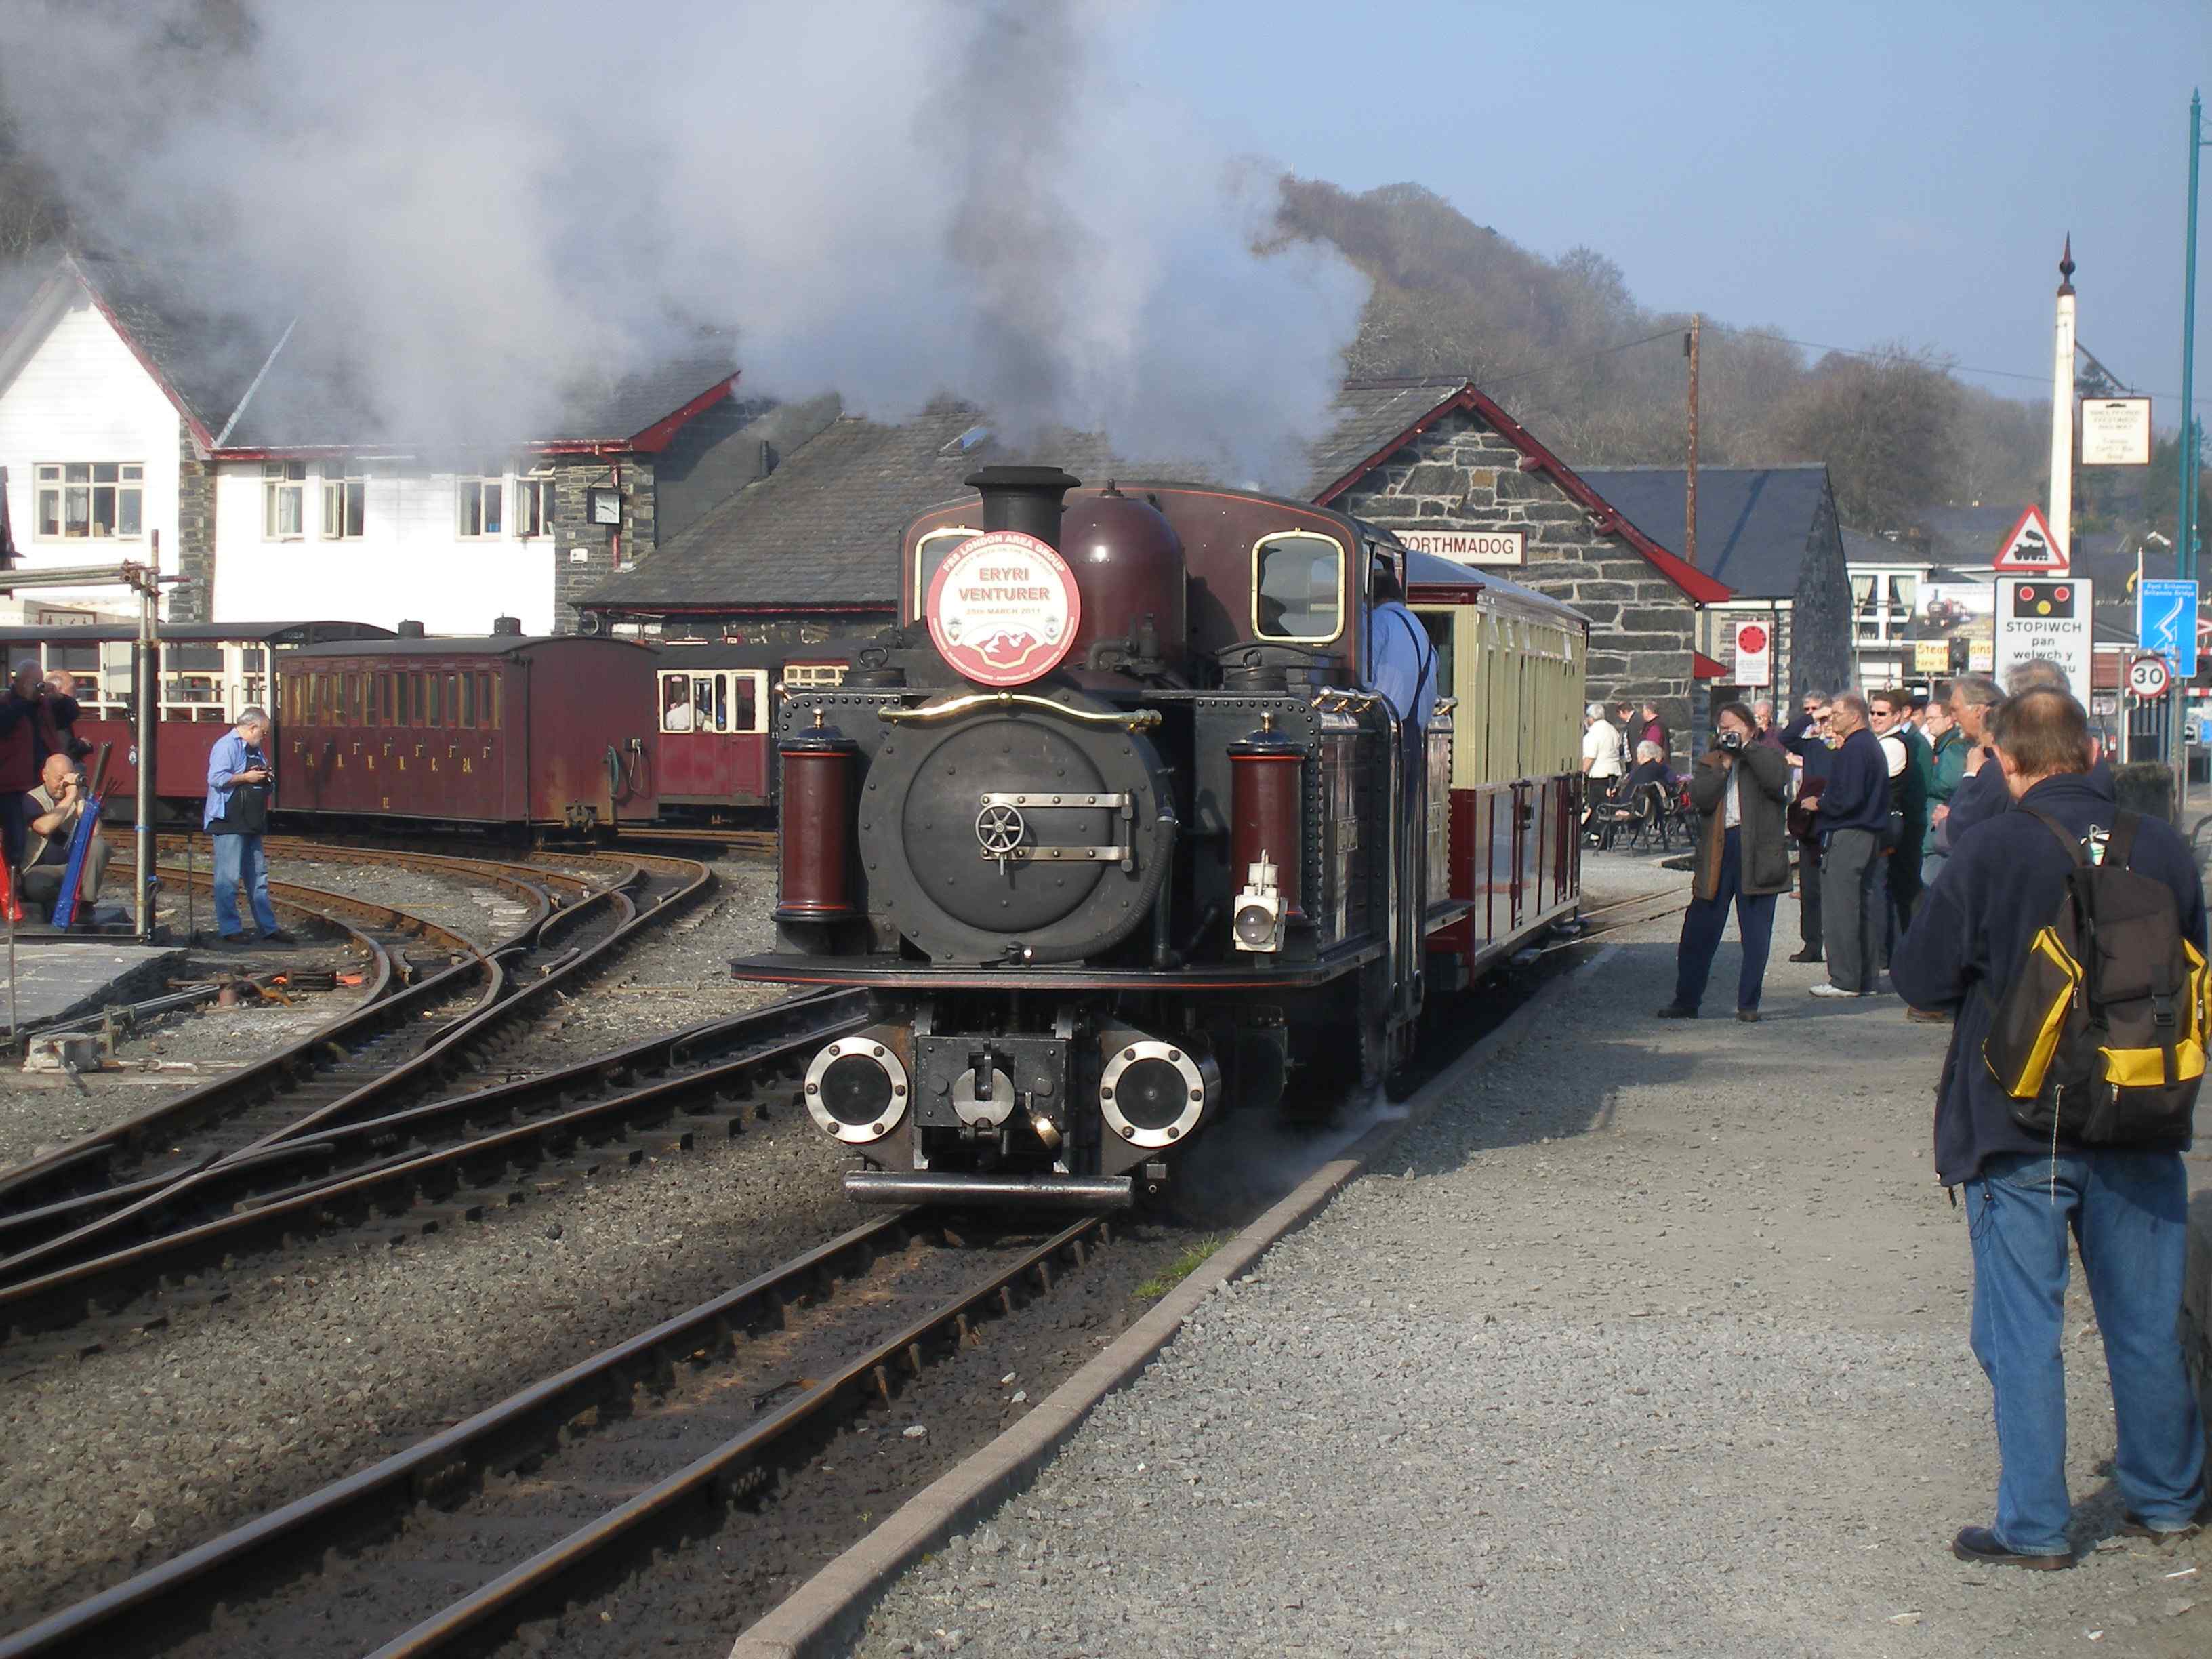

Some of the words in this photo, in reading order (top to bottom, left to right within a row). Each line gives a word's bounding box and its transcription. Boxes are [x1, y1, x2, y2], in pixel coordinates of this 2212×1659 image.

[960, 534, 1003, 555] LONDON
[1005, 534, 1033, 550] AREA
[1034, 544, 1066, 572] GROUP
[979, 567, 1029, 581] ERYRI
[958, 587, 1050, 602] VENTURER
[2006, 621, 2082, 632] STOPIWCH
[2032, 638, 2055, 647] pan
[1970, 644, 1992, 655] ains
[2013, 649, 2062, 659] welwch
[2066, 652, 2073, 661] y
[2134, 668, 2163, 684] 30
